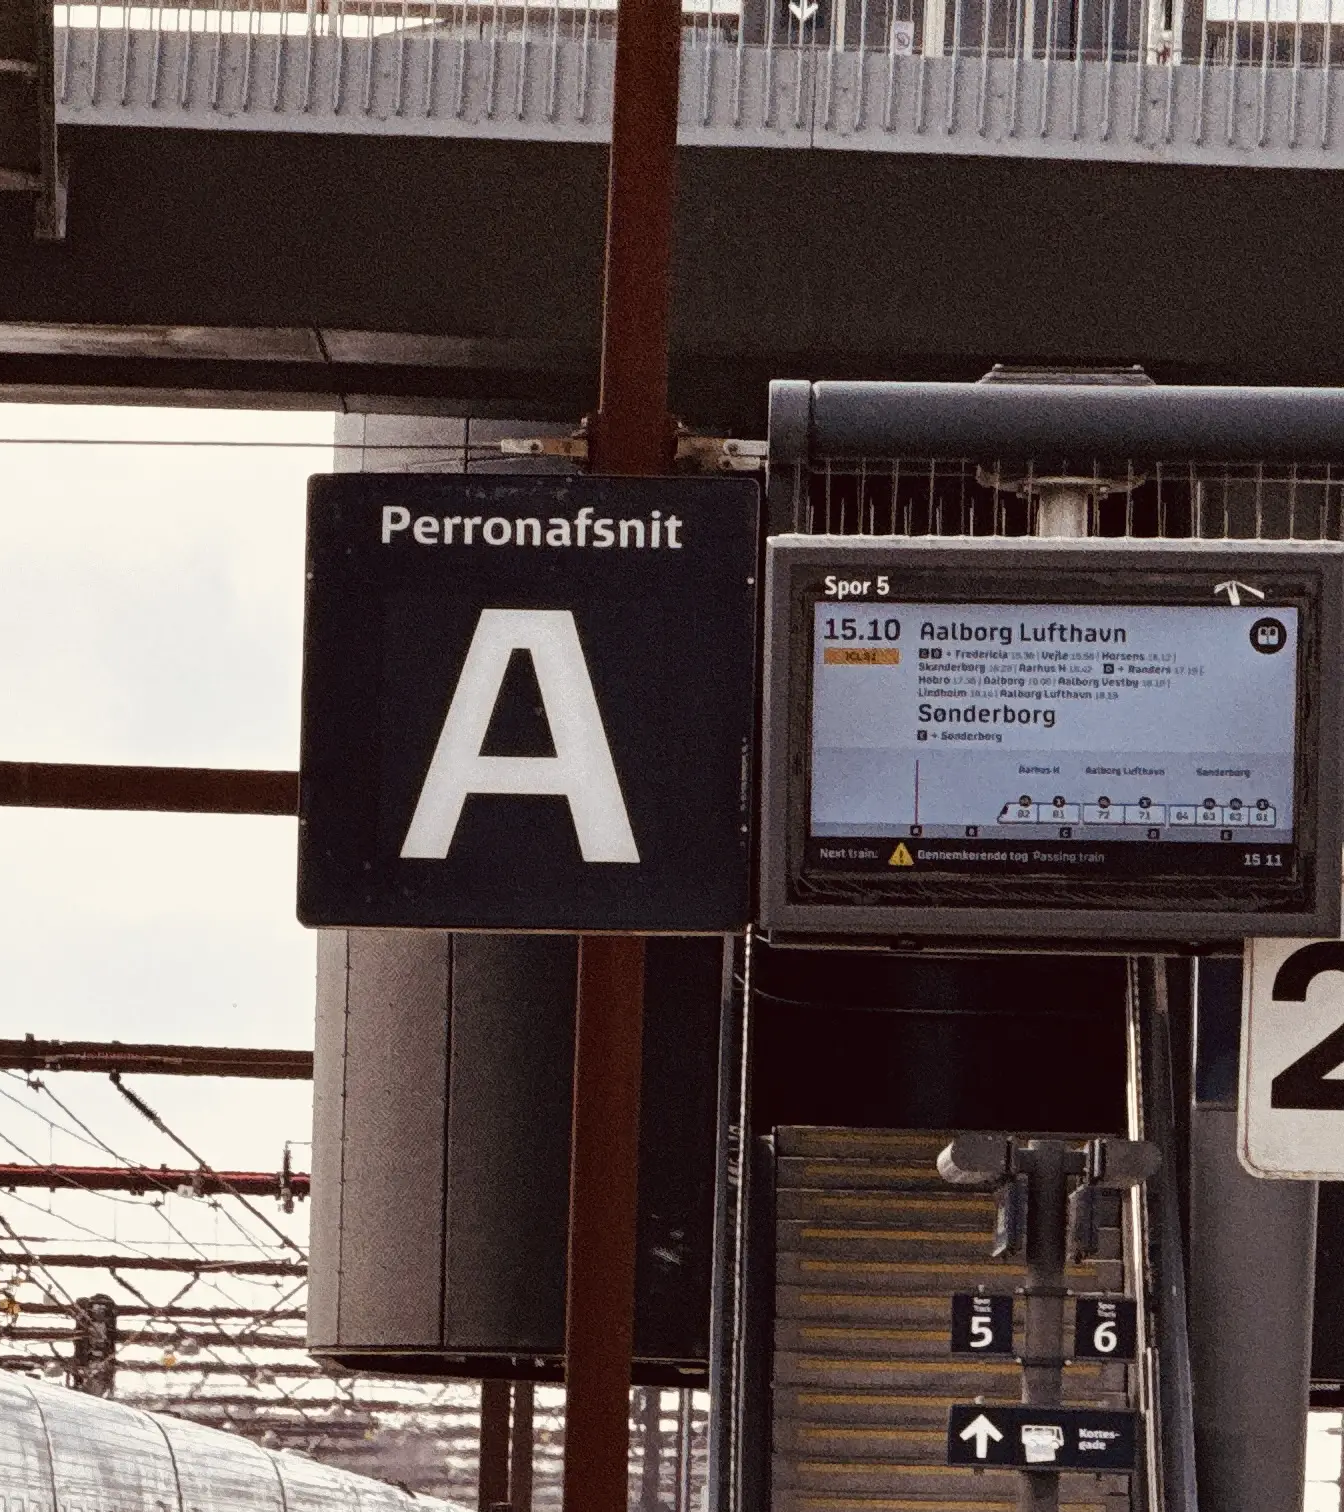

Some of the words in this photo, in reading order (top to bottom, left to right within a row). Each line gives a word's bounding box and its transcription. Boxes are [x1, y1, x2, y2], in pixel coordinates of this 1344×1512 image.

[380, 504, 684, 550] Perronafsnit
[824, 575, 871, 600] Spor
[876, 575, 890, 595] 5
[823, 617, 901, 641] 15.10
[919, 621, 1012, 646] Aalborg
[1019, 622, 1126, 643] Lufthavn
[955, 650, 1008, 660] Fredericia
[1041, 651, 1069, 662] Vejle
[1101, 651, 1145, 661] Horsens
[918, 663, 985, 674] Skanderborg
[1018, 663, 1055, 673] Aarhus
[1127, 665, 1171, 674] Randers
[918, 676, 950, 685] Hobro
[983, 676, 1024, 687] Aalborg
[1057, 677, 1099, 688] Aalborg
[999, 688, 1041, 700] Aalborg
[1044, 689, 1092, 699] Lufthavn
[917, 703, 1056, 728] Sønderborg
[399, 608, 641, 864] A
[940, 730, 1003, 743] Sønderborg
[819, 848, 845, 859] Next
[1009, 850, 1029, 863] tog
[1033, 850, 1076, 863] Passing
[1078, 851, 1105, 863] train
[1270, 940, 1344, 1110] 2
[969, 1316, 993, 1348] 5
[1093, 1320, 1118, 1353] 6
